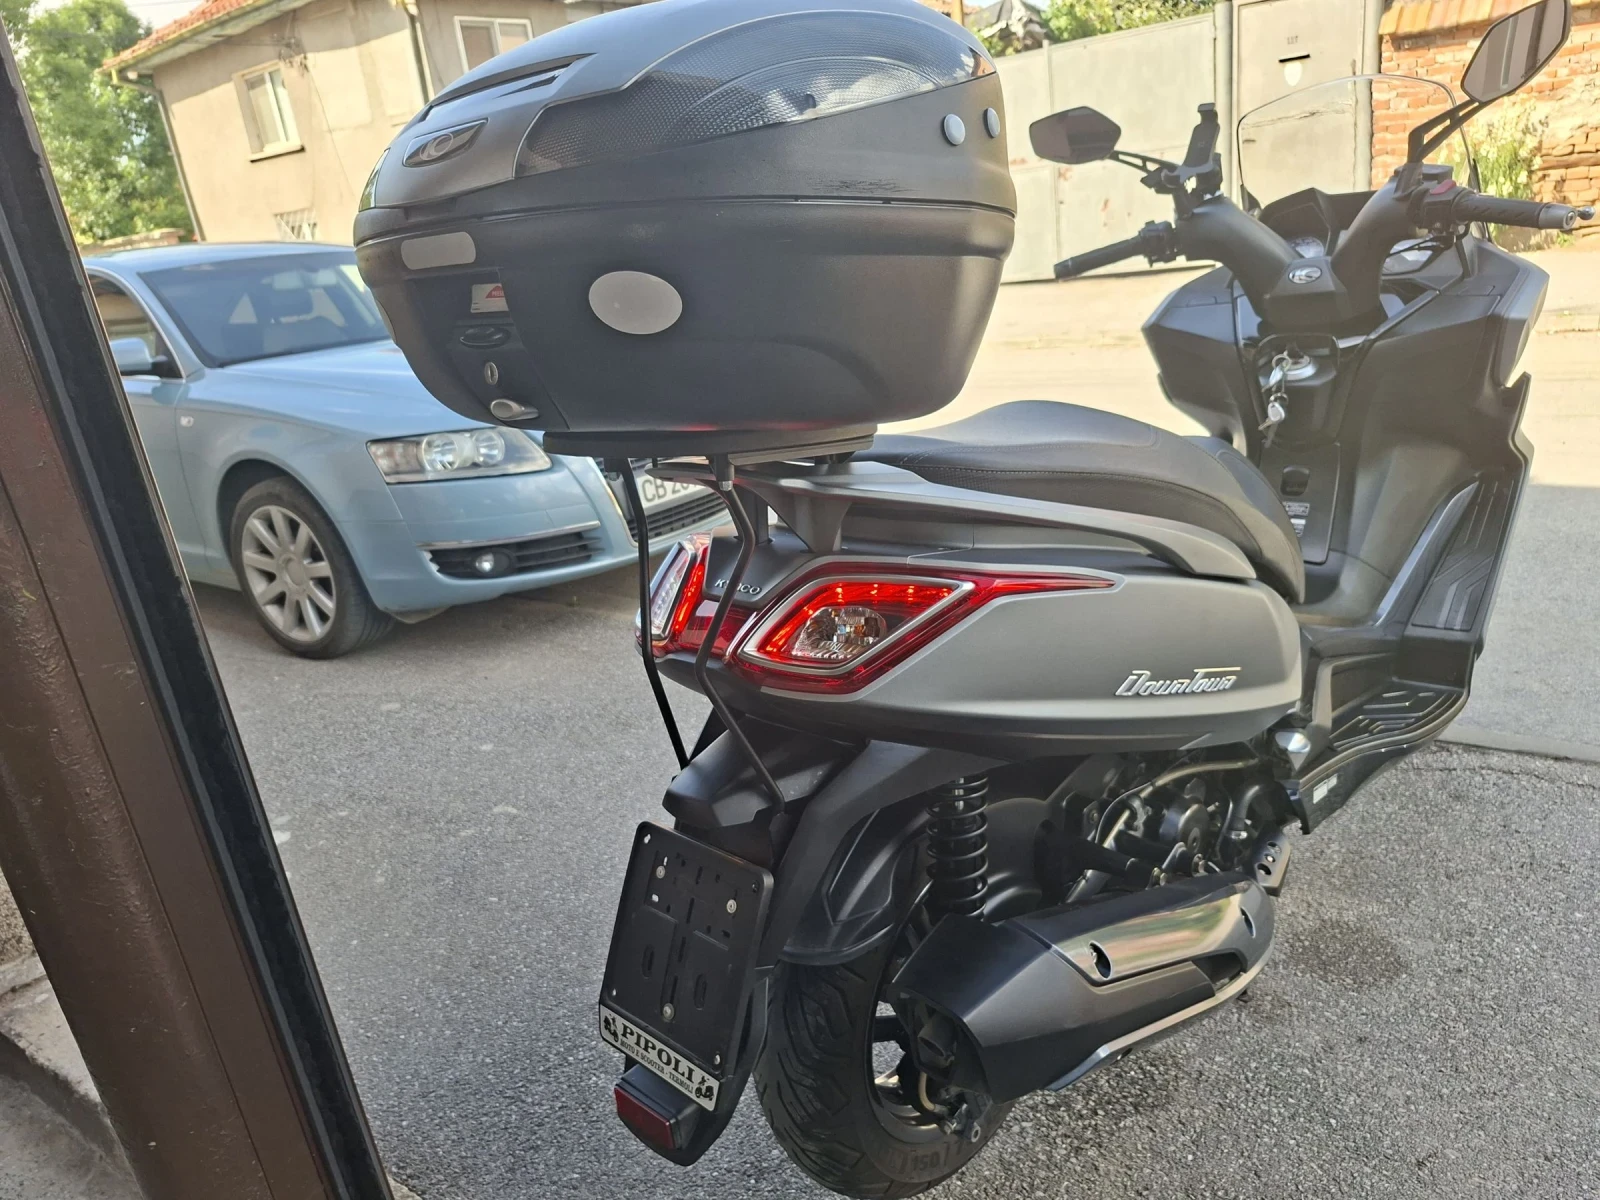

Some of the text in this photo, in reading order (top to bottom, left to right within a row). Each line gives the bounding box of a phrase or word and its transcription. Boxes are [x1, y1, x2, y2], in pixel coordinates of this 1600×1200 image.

[1115, 667, 1241, 696] DownTown
[620, 1038, 636, 1053] MOTO
[640, 1054, 664, 1075] SCOOTER
[669, 1072, 694, 1094] TERMOLI
[621, 1022, 696, 1084] PIPOLI
